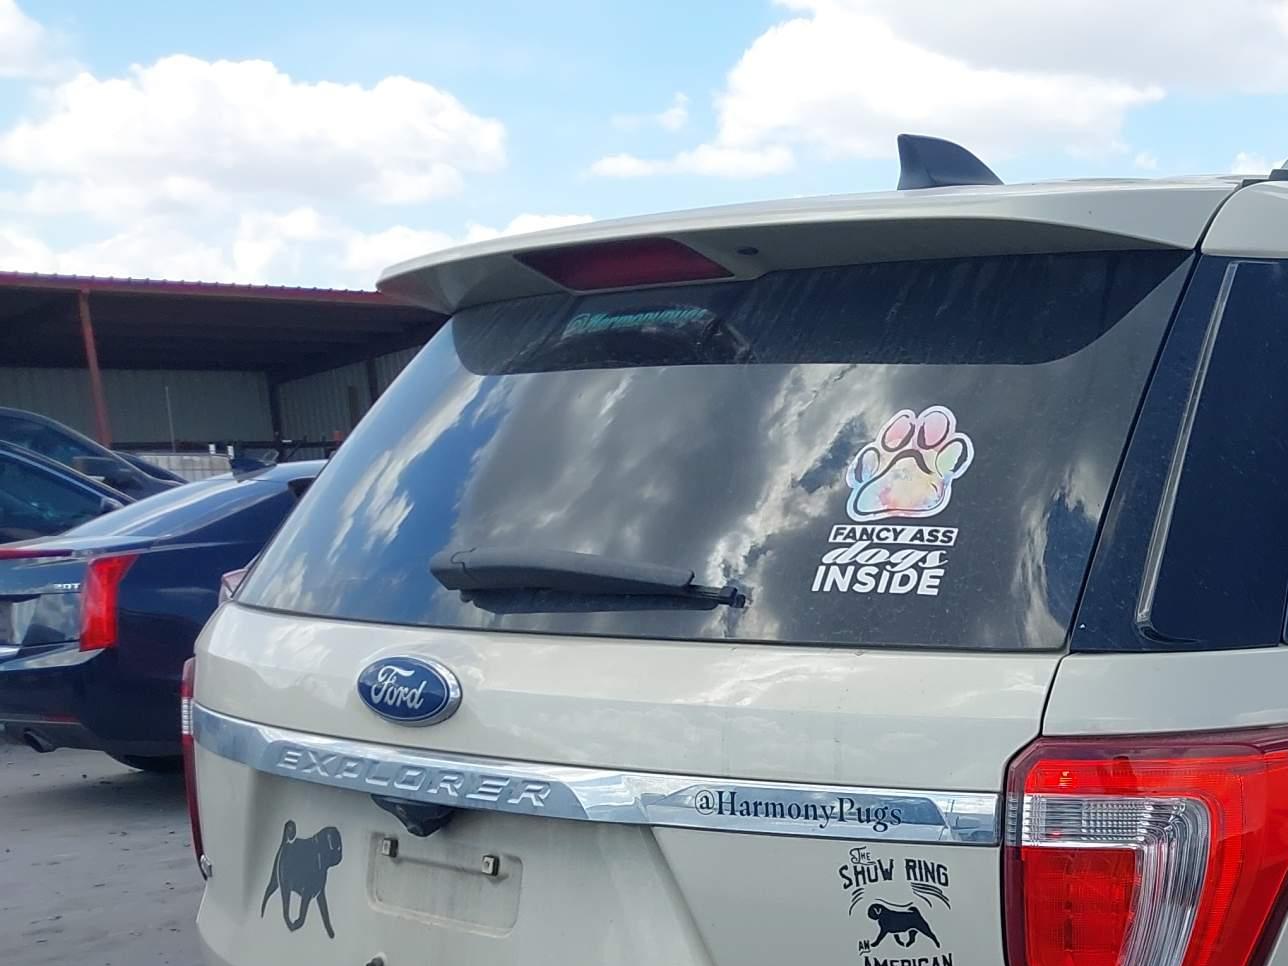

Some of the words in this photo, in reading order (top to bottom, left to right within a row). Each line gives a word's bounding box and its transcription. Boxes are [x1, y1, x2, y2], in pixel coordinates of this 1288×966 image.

[832, 527, 905, 542] FANCY
[910, 529, 954, 544] ASS
[822, 541, 948, 571] dogs
[811, 565, 944, 595] INSIDE
[371, 665, 427, 709] Ford
[277, 748, 551, 807] EXPLORER
[694, 789, 902, 832] @HarmonyPugs
[839, 859, 894, 889] SHOW
[904, 859, 949, 887] RING
